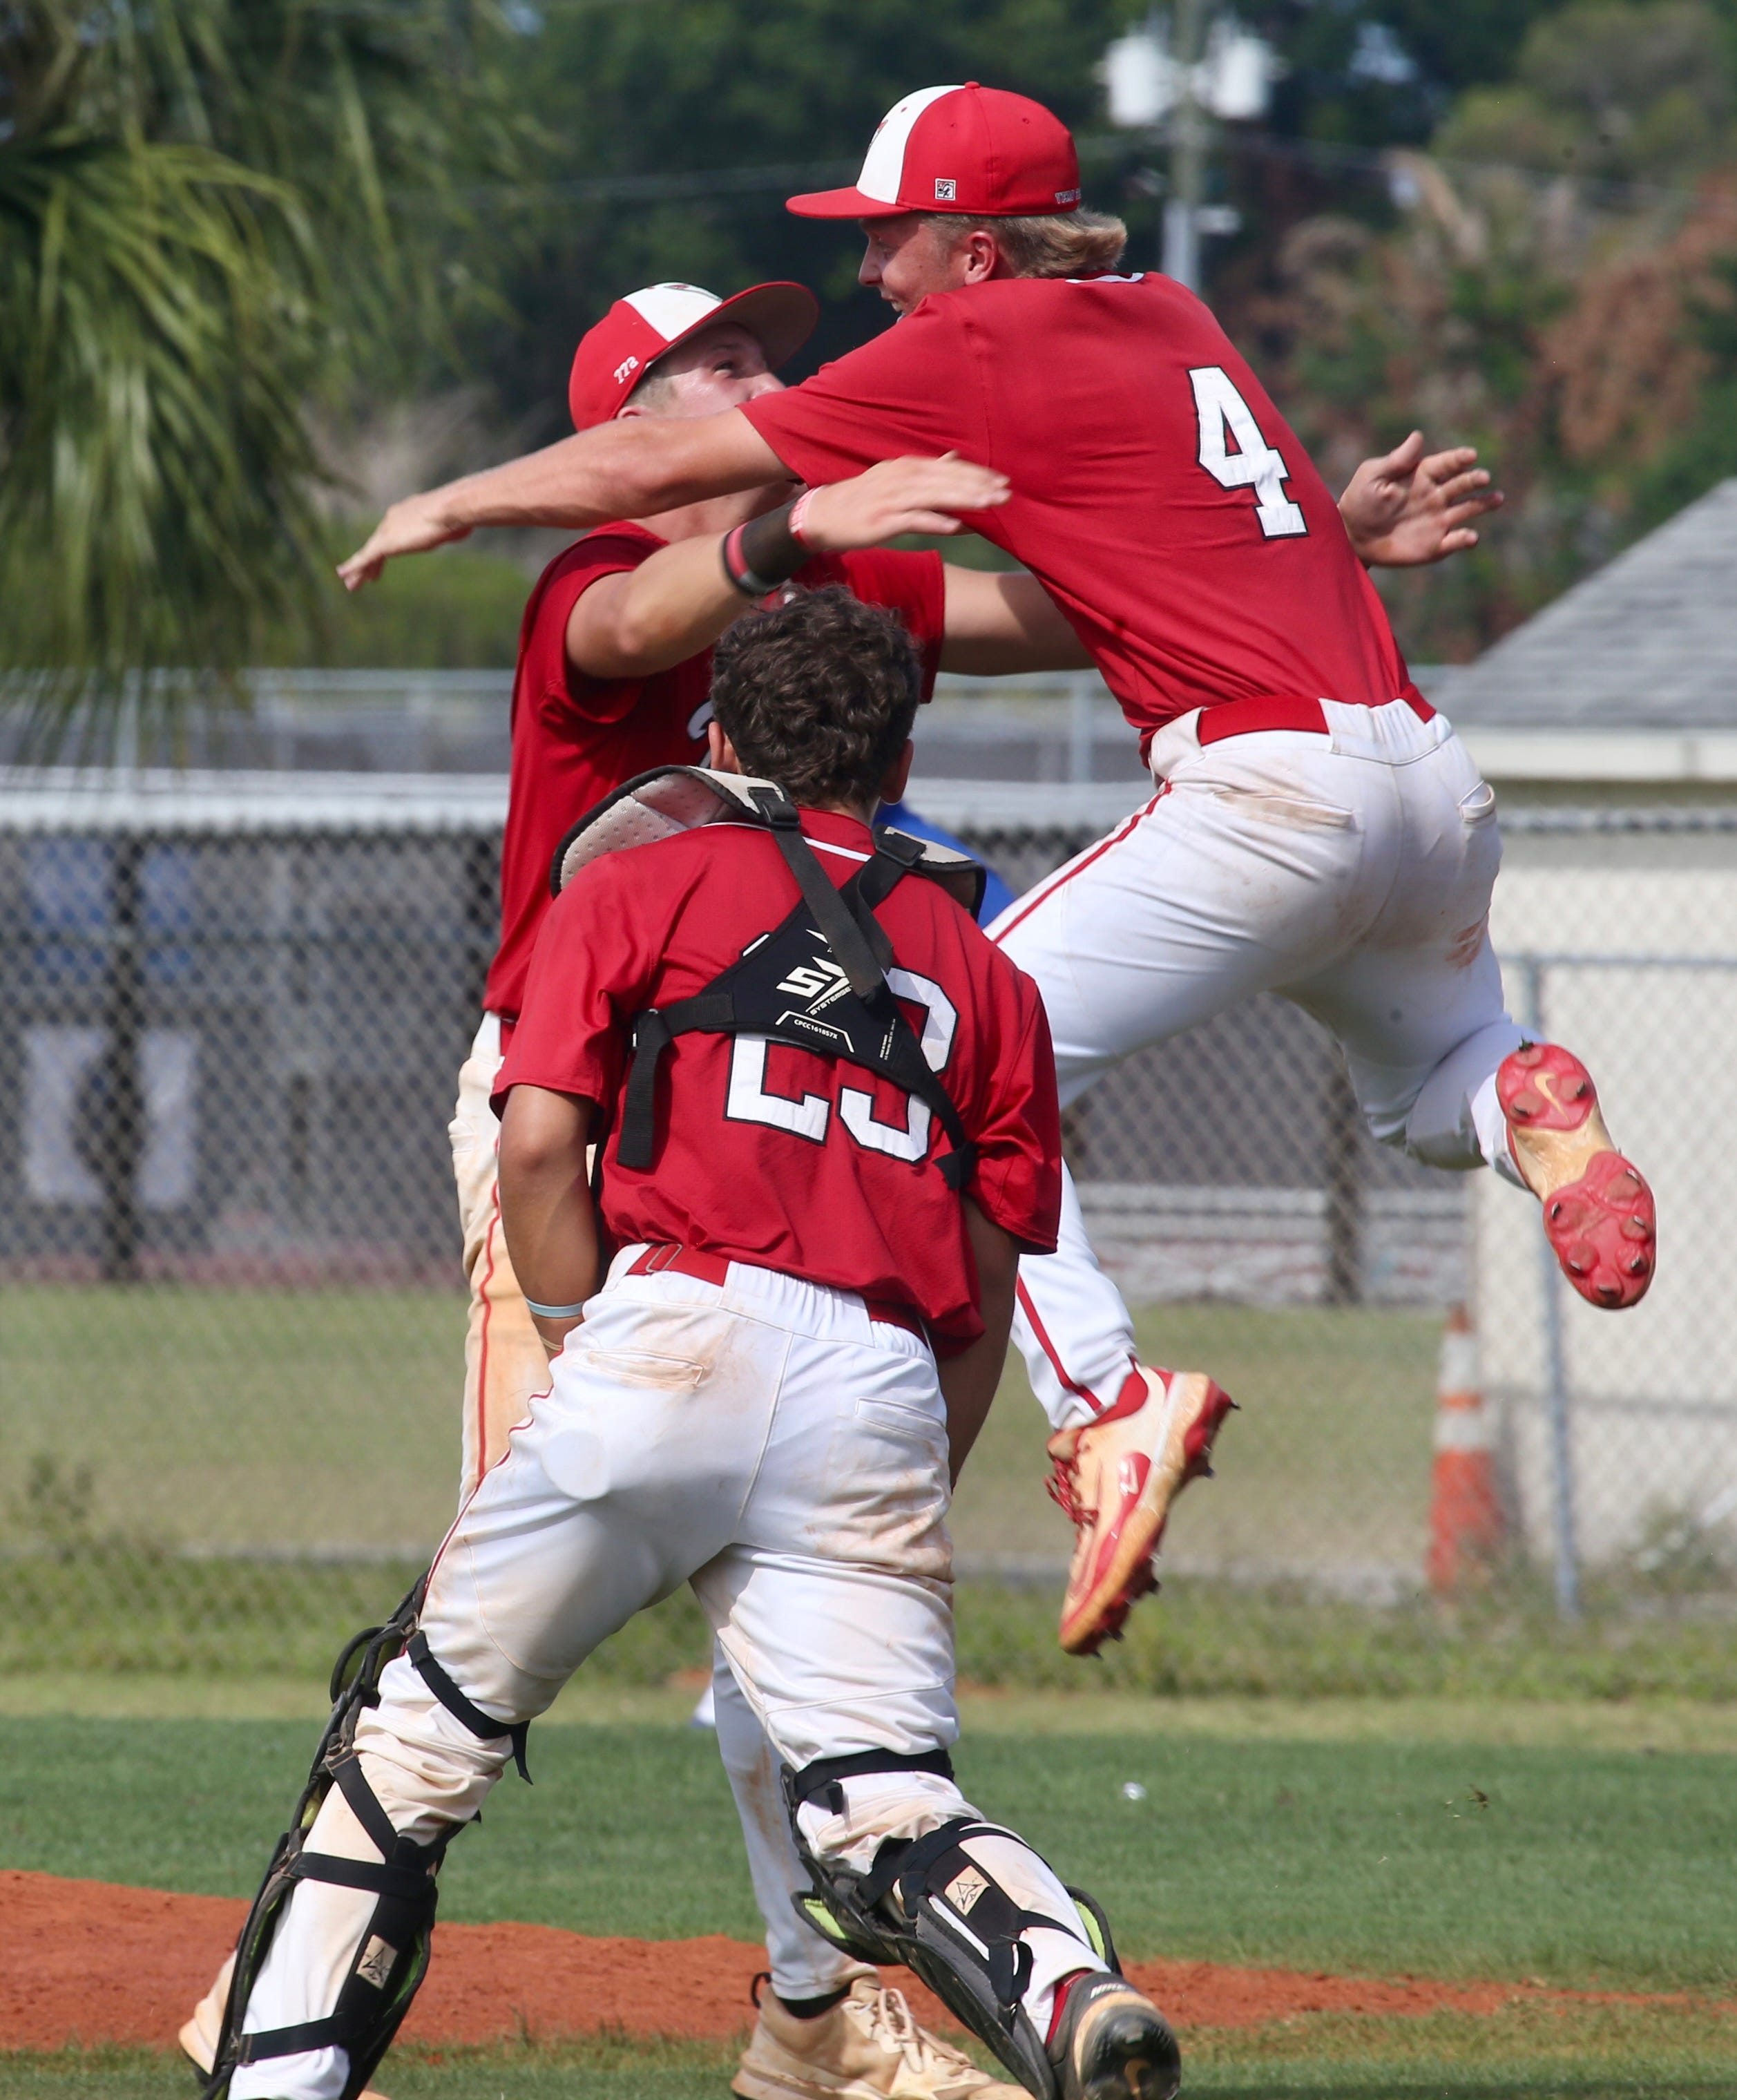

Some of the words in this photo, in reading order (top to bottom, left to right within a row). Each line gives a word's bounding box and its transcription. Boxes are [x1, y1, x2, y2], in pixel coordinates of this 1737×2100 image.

[613, 355, 640, 385] 772
[1187, 365, 1309, 542] 4
[724, 932, 959, 1165] 23
